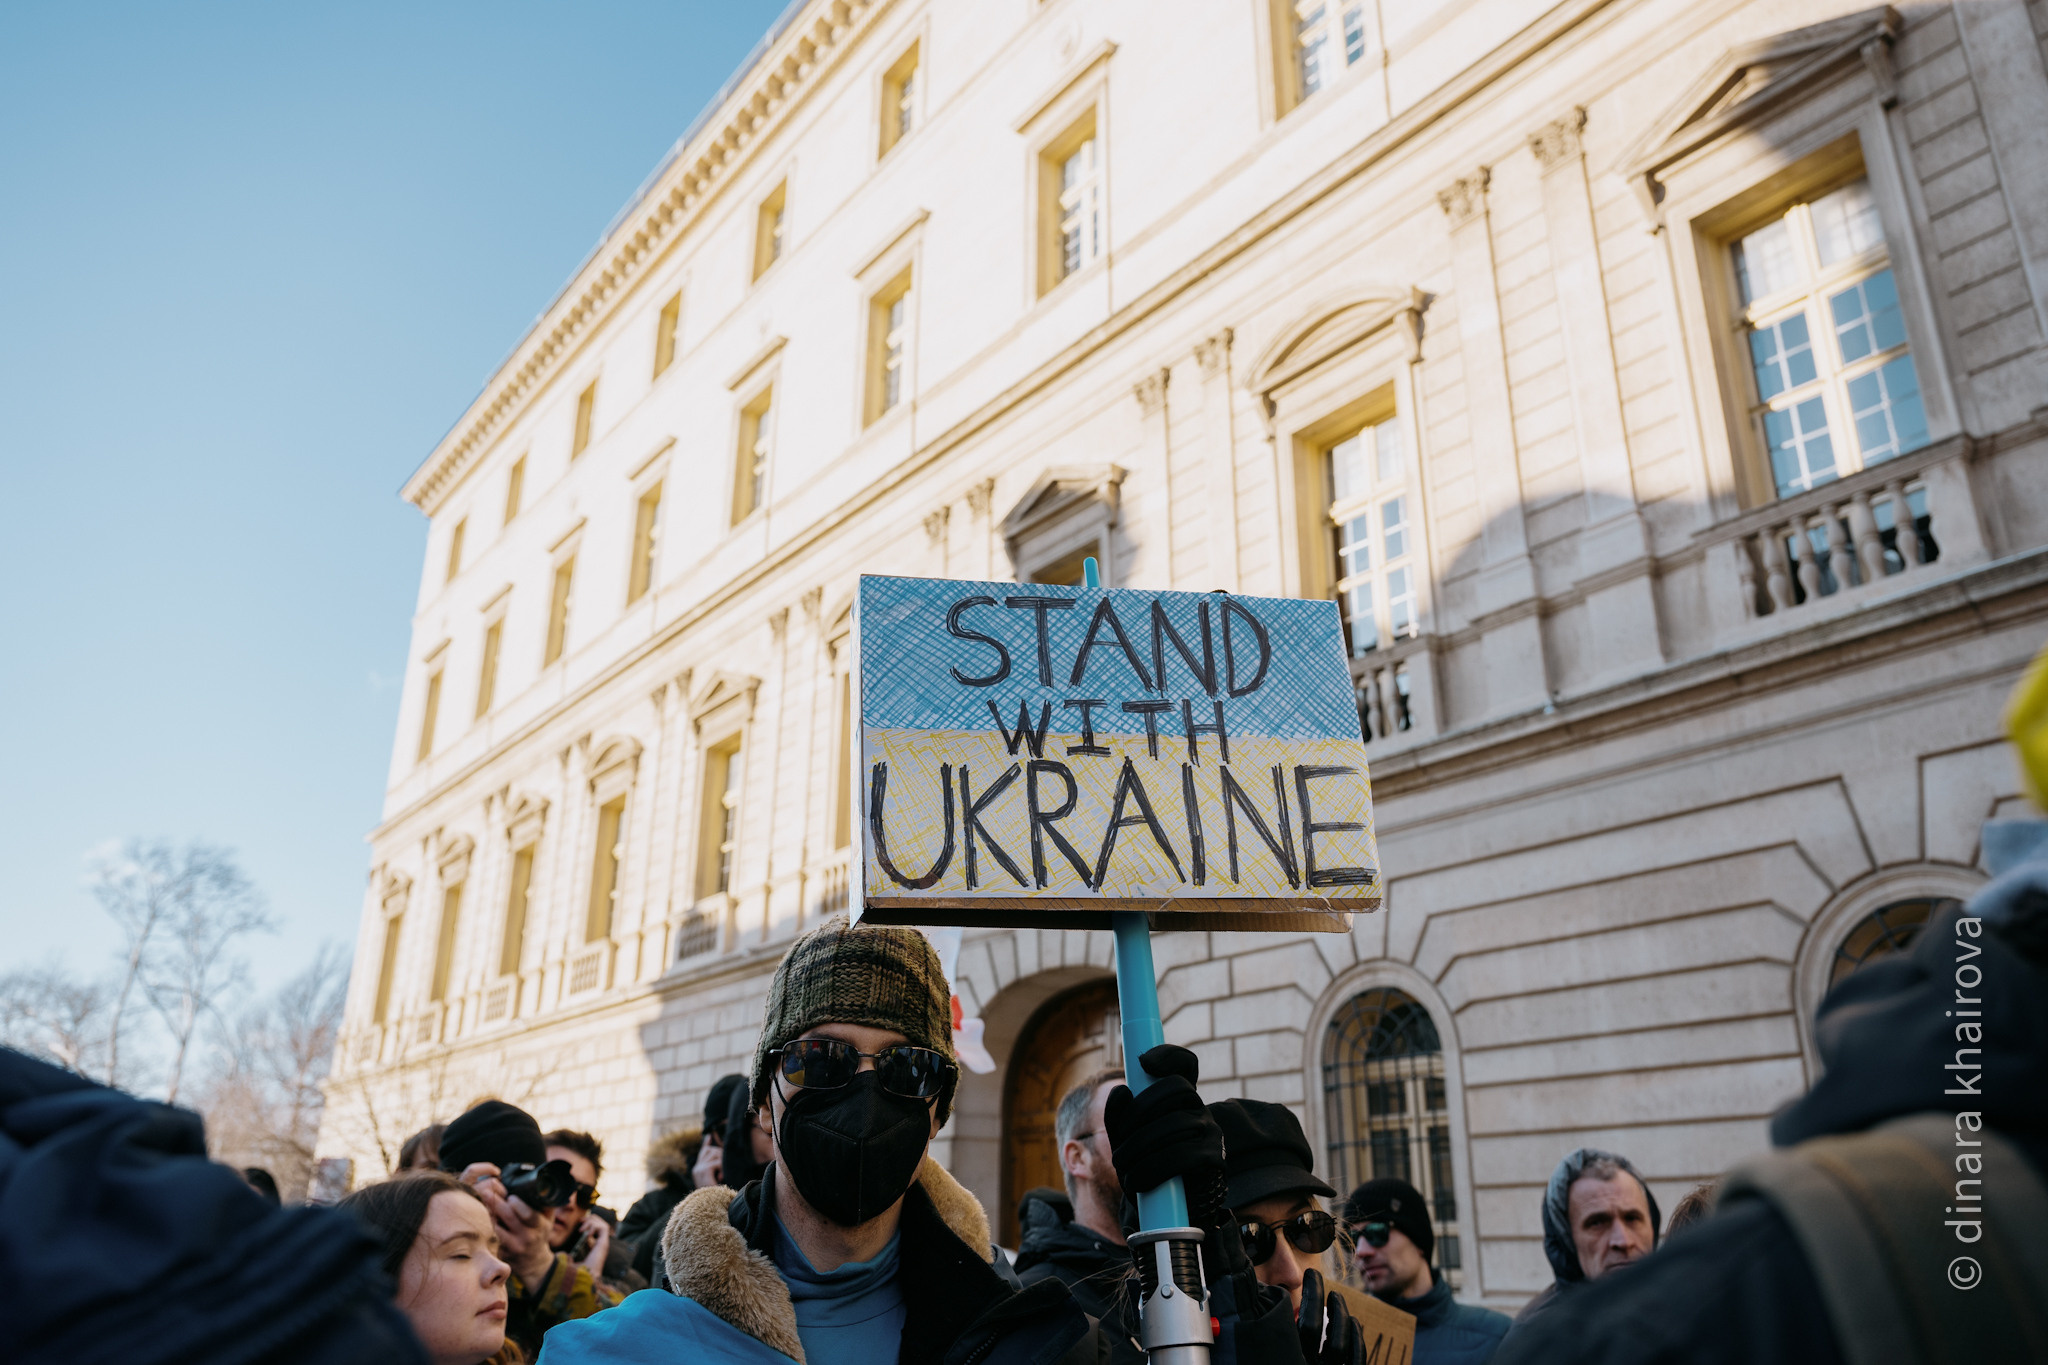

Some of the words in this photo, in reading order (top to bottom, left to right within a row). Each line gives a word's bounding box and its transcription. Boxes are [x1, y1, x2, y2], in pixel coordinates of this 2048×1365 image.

[946, 595, 1272, 698] STAND
[987, 699, 1231, 766] WITH
[870, 756, 1378, 892] UKRAINE
